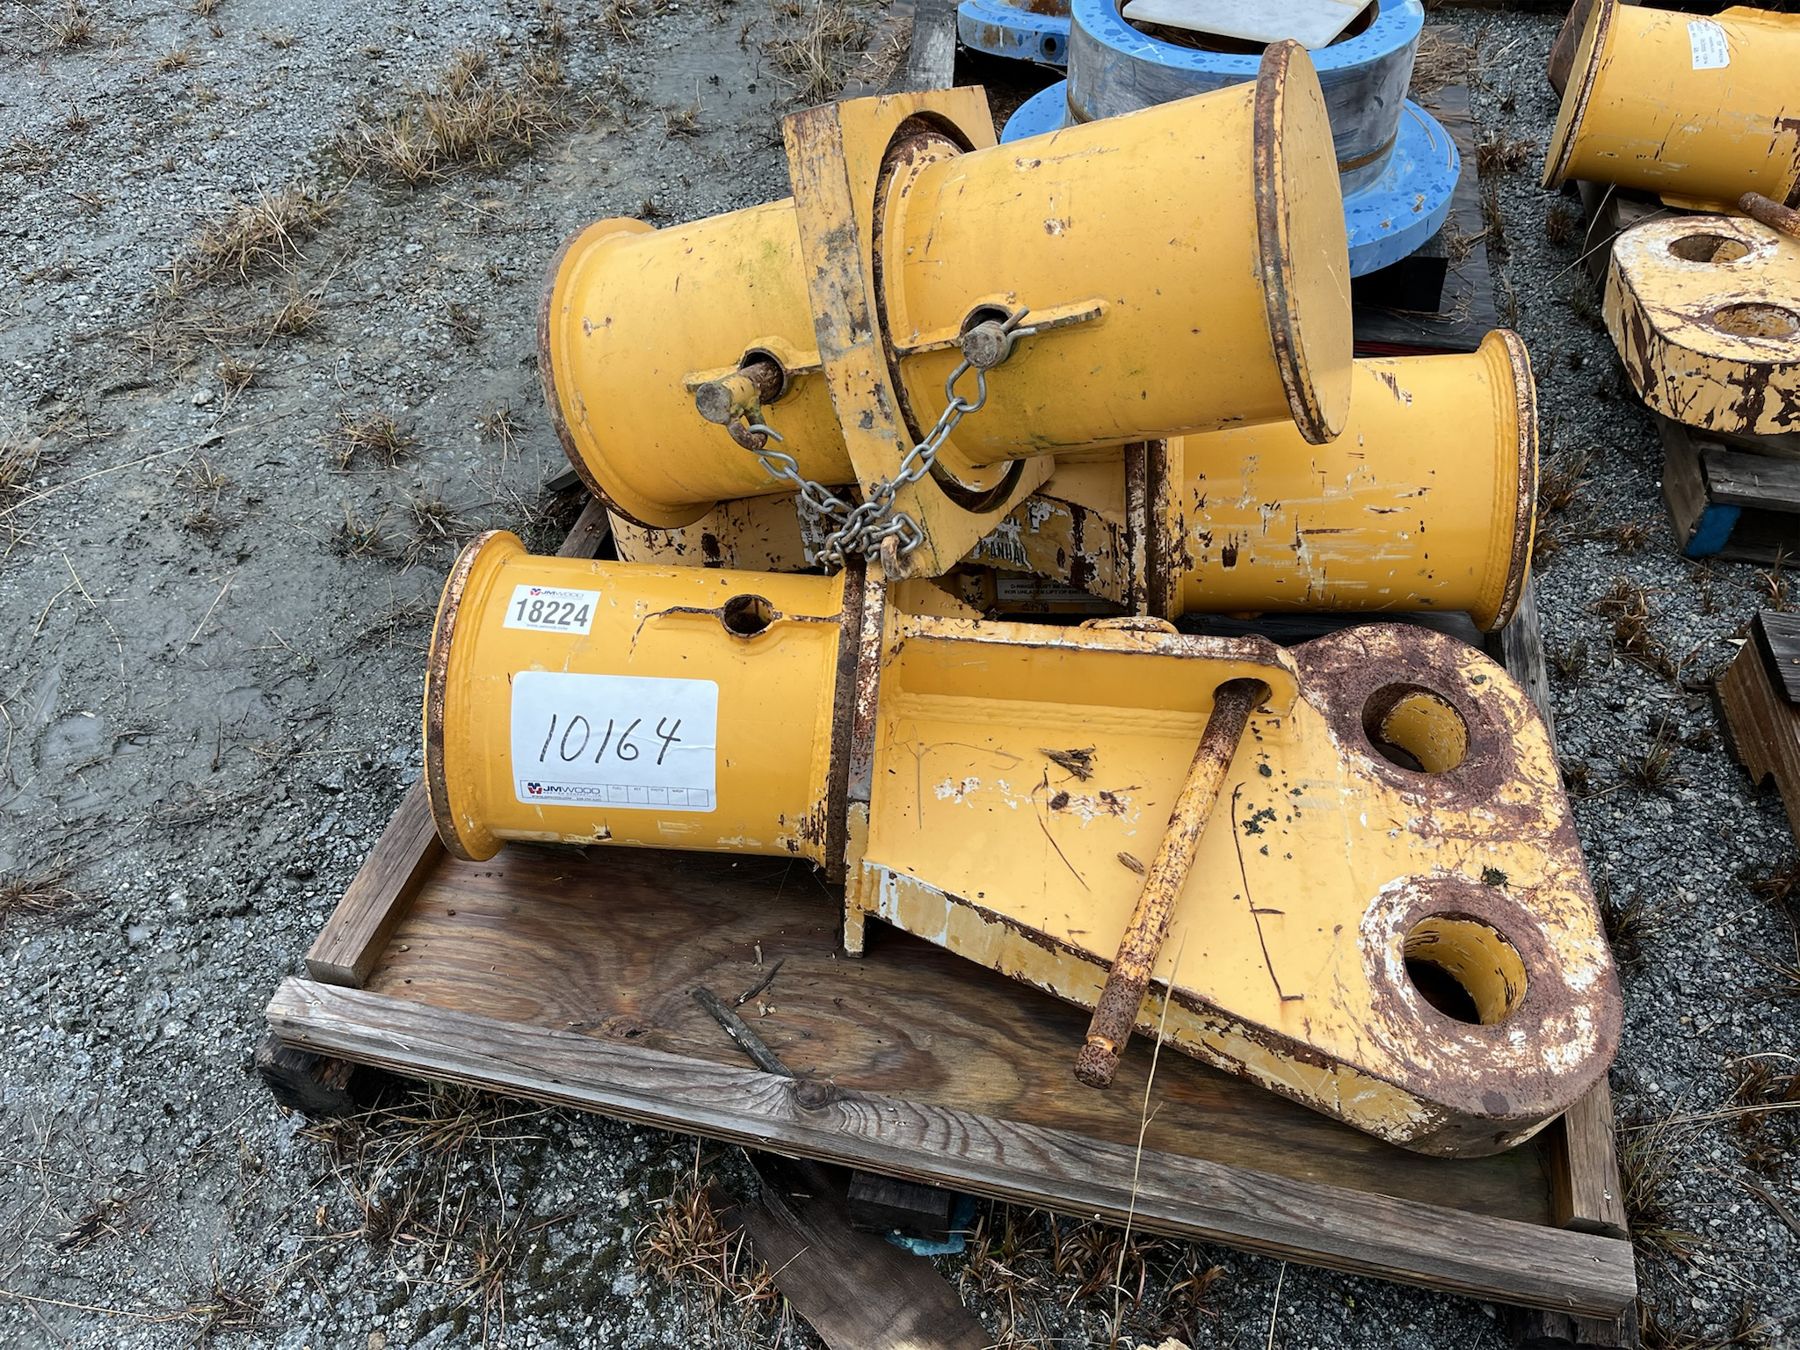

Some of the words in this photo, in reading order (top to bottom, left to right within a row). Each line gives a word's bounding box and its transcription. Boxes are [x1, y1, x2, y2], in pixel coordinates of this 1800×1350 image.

[516, 598, 590, 627] 18224
[539, 713, 682, 765] 10164
[543, 785, 600, 795] JMWOOD
